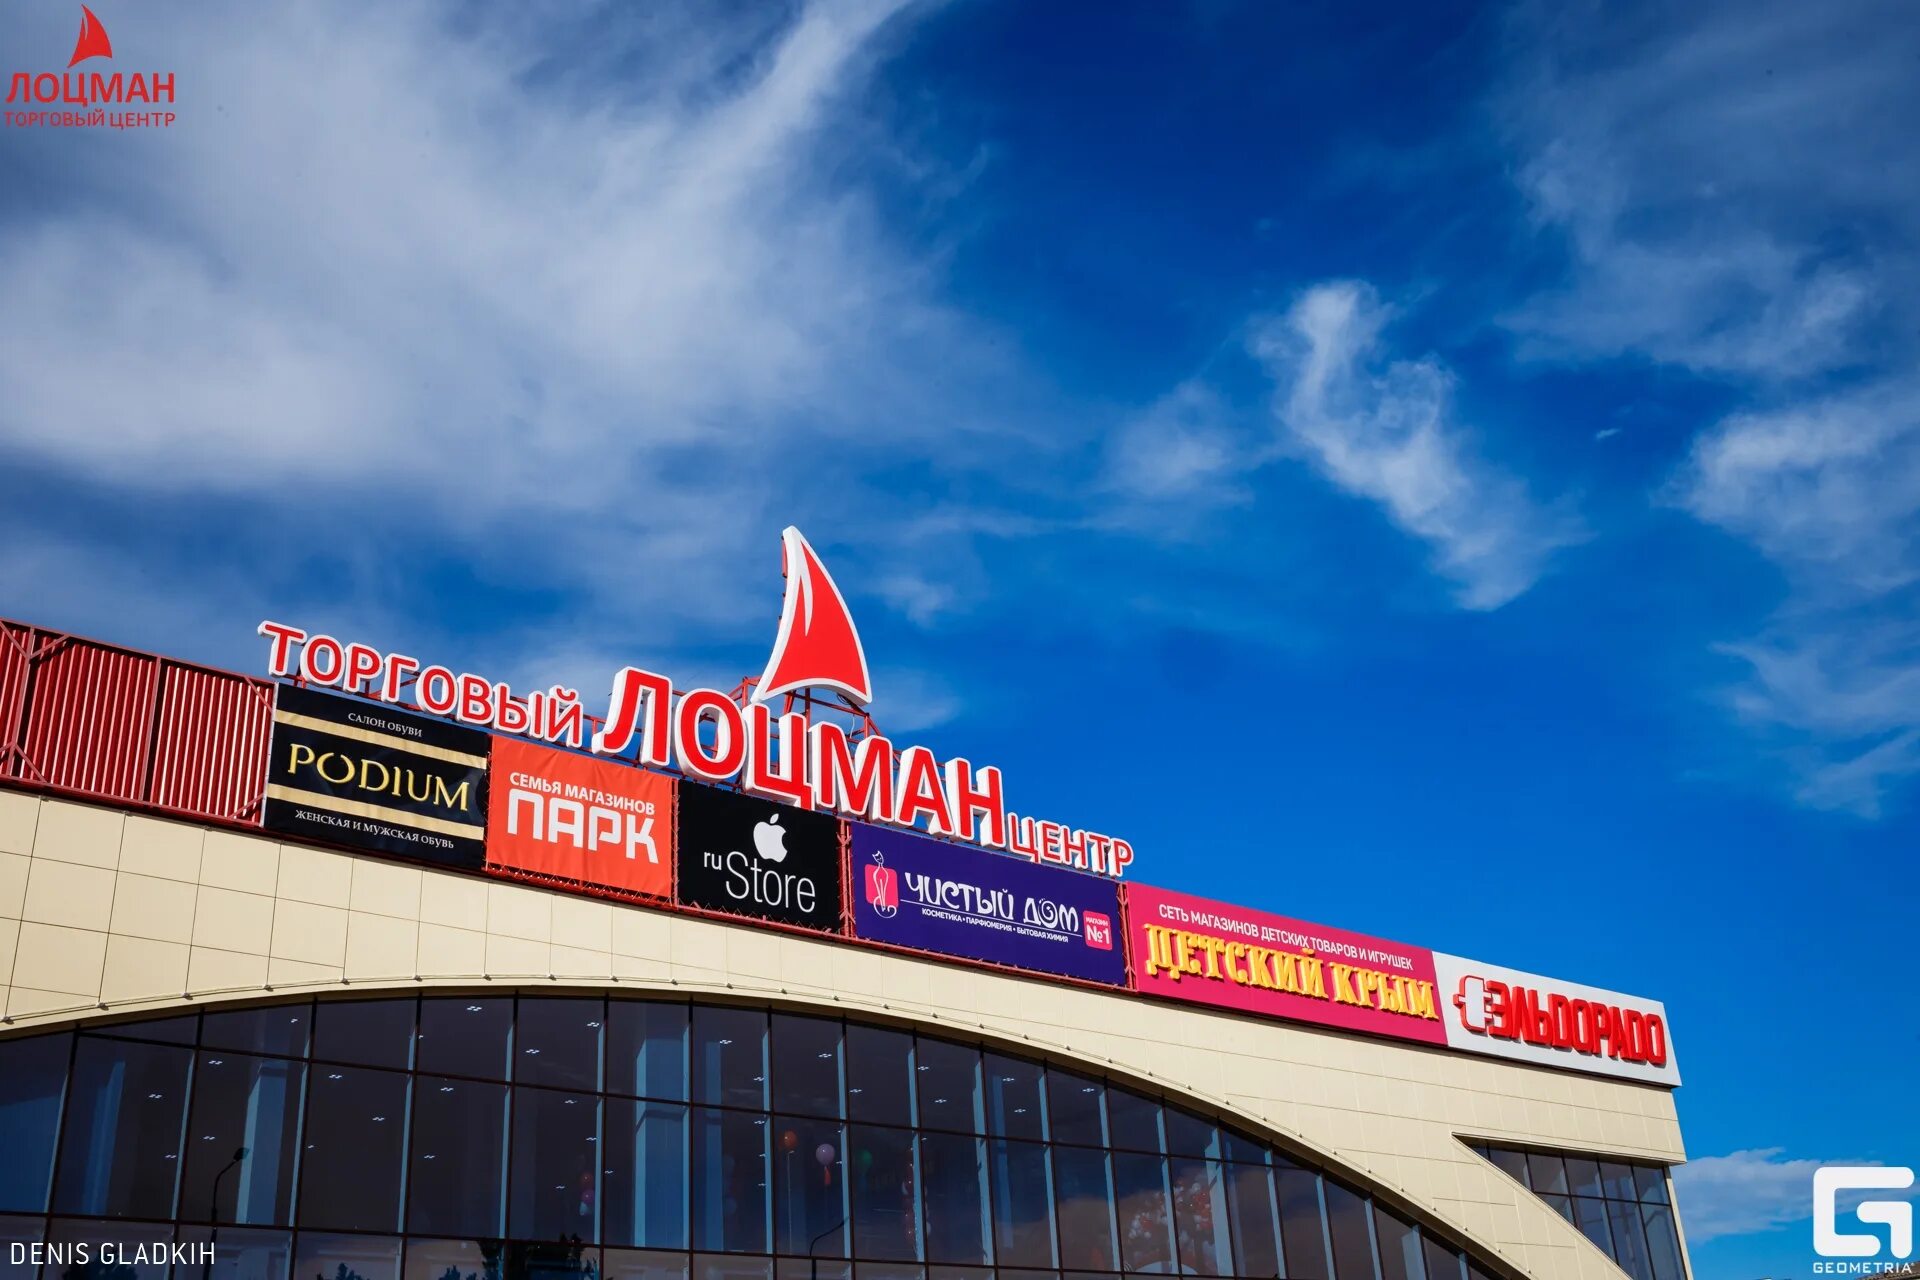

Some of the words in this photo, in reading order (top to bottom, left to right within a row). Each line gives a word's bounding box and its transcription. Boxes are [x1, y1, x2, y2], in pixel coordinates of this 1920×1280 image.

[258, 620, 584, 748] ТОРГОВЫЙ
[592, 666, 1007, 849] ЛОЦМАН
[1008, 812, 1134, 878] ЦЕНТР
[347, 712, 386, 728] САЛОН
[387, 722, 423, 738] ОБУВИ
[287, 743, 470, 812] PODIUM
[509, 771, 562, 795] СЕМЬЯ
[565, 783, 655, 816] МАГАЗИНОВ
[295, 809, 350, 829] ЖЕНСКАЯ
[352, 821, 362, 831] И
[363, 823, 419, 842] МУЖСКАЯ
[420, 835, 454, 849] ОБУВЬ
[507, 788, 659, 864] ПАРК
[703, 850, 722, 871] ru
[725, 850, 816, 914] Store
[904, 872, 1015, 921] ЧИСТЫЙ
[1023, 897, 1079, 933] ДОМ
[922, 907, 963, 923] КОСМЕТИКА
[966, 916, 1012, 932] ПАРФЮМЕРИЯ
[1016, 926, 1047, 939] БЫТОВАЯ
[1046, 931, 1068, 943] ХИМИЯ
[1158, 903, 1189, 922] СЕТЬ
[1190, 911, 1259, 938] МАГАЗИНОВ
[1260, 926, 1310, 949] ДЕТСКИХ
[1309, 936, 1358, 959] ТОВАРОВ
[1358, 950, 1367, 960] И
[1367, 950, 1414, 971] ИГРУШЕК
[1143, 923, 1329, 999] ДЕТСКИЙ
[1328, 961, 1439, 1020] КРЫМ
[1486, 980, 1667, 1066] ЭЛЬДОРАДО
